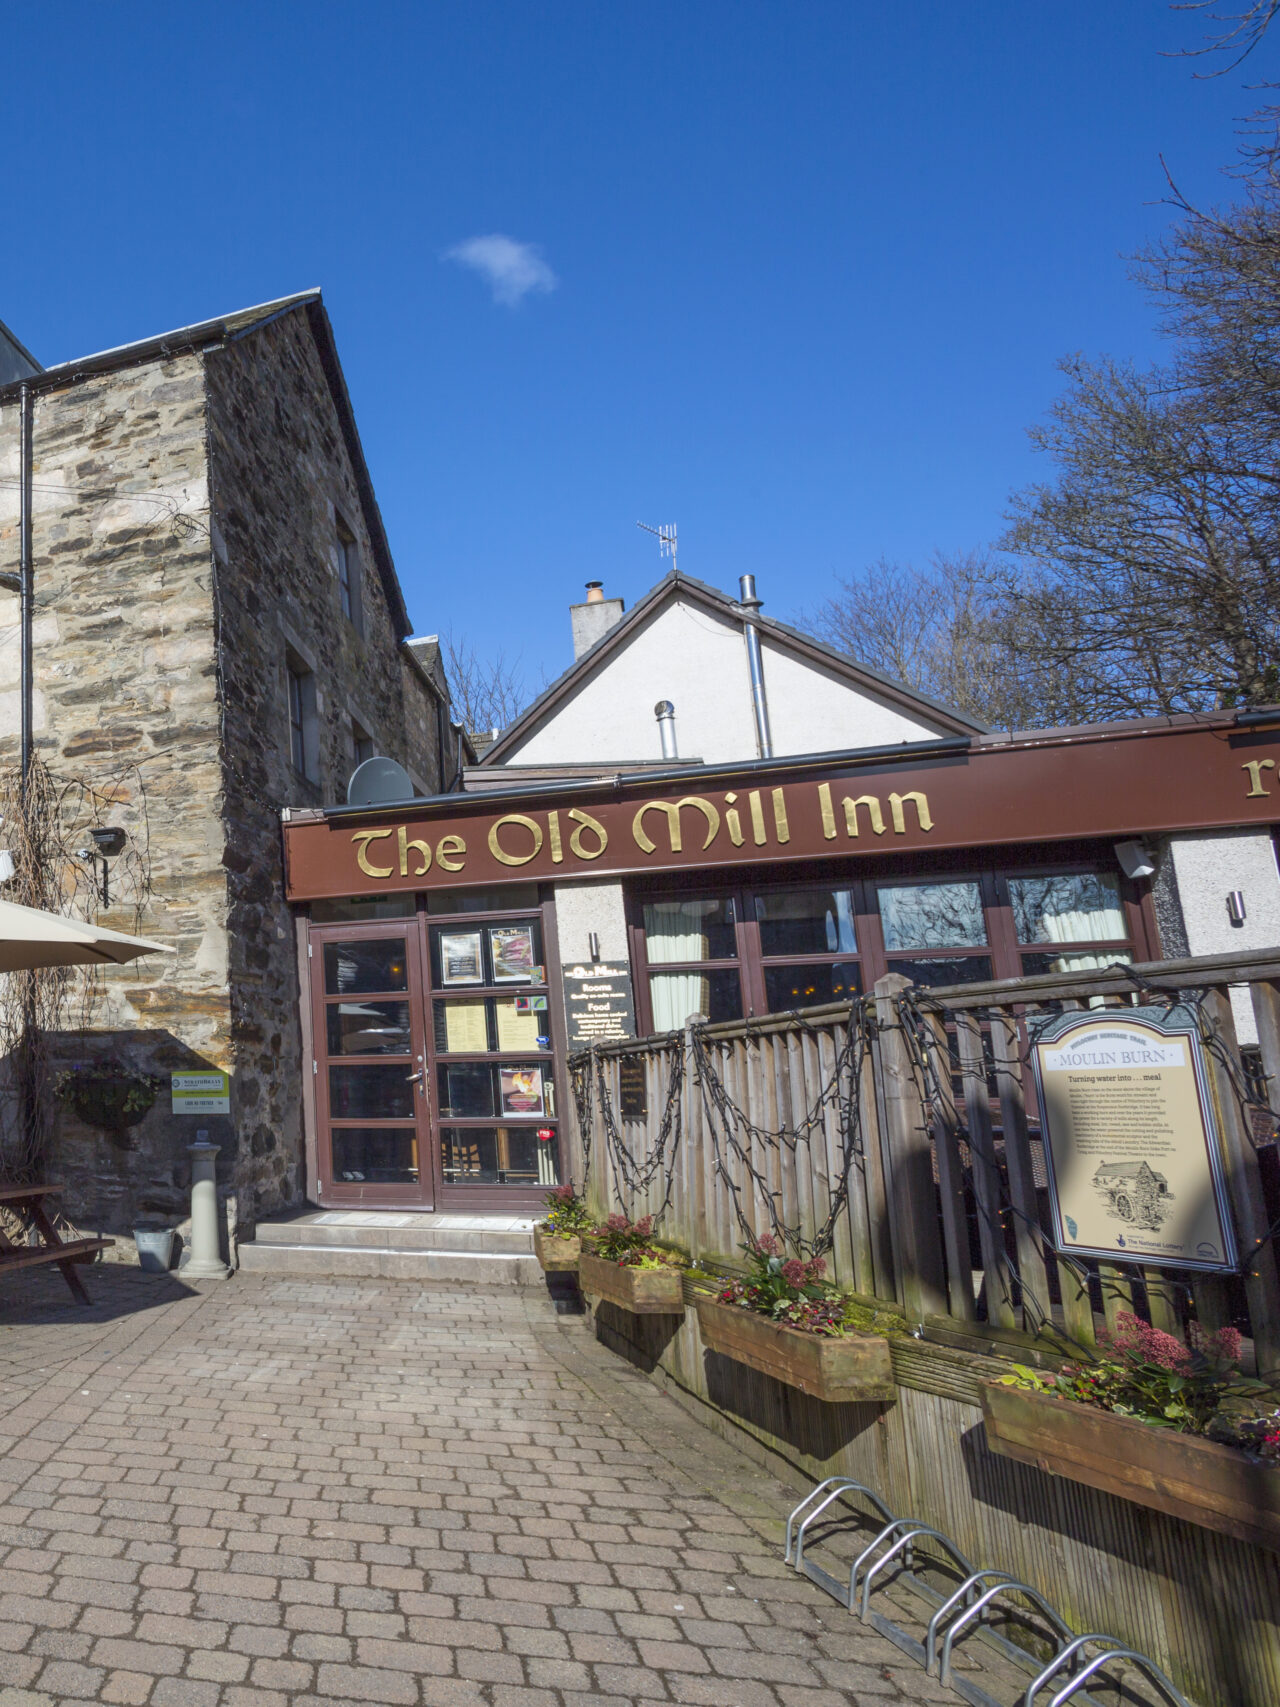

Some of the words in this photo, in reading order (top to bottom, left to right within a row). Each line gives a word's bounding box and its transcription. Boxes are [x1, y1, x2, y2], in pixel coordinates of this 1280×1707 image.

[351, 825, 466, 878] The
[488, 808, 608, 867] Old
[632, 787, 790, 854] Mill
[818, 782, 935, 840] Inn
[582, 983, 612, 992] Rooms
[587, 1002, 610, 1011] Food
[1059, 1051, 1117, 1067] MOULIN
[1120, 1049, 1166, 1064] BURN
[1068, 1075, 1096, 1084] Turning
[1117, 1073, 1132, 1081] into
[1143, 1072, 1162, 1081] meal
[1138, 1239, 1161, 1247] National
